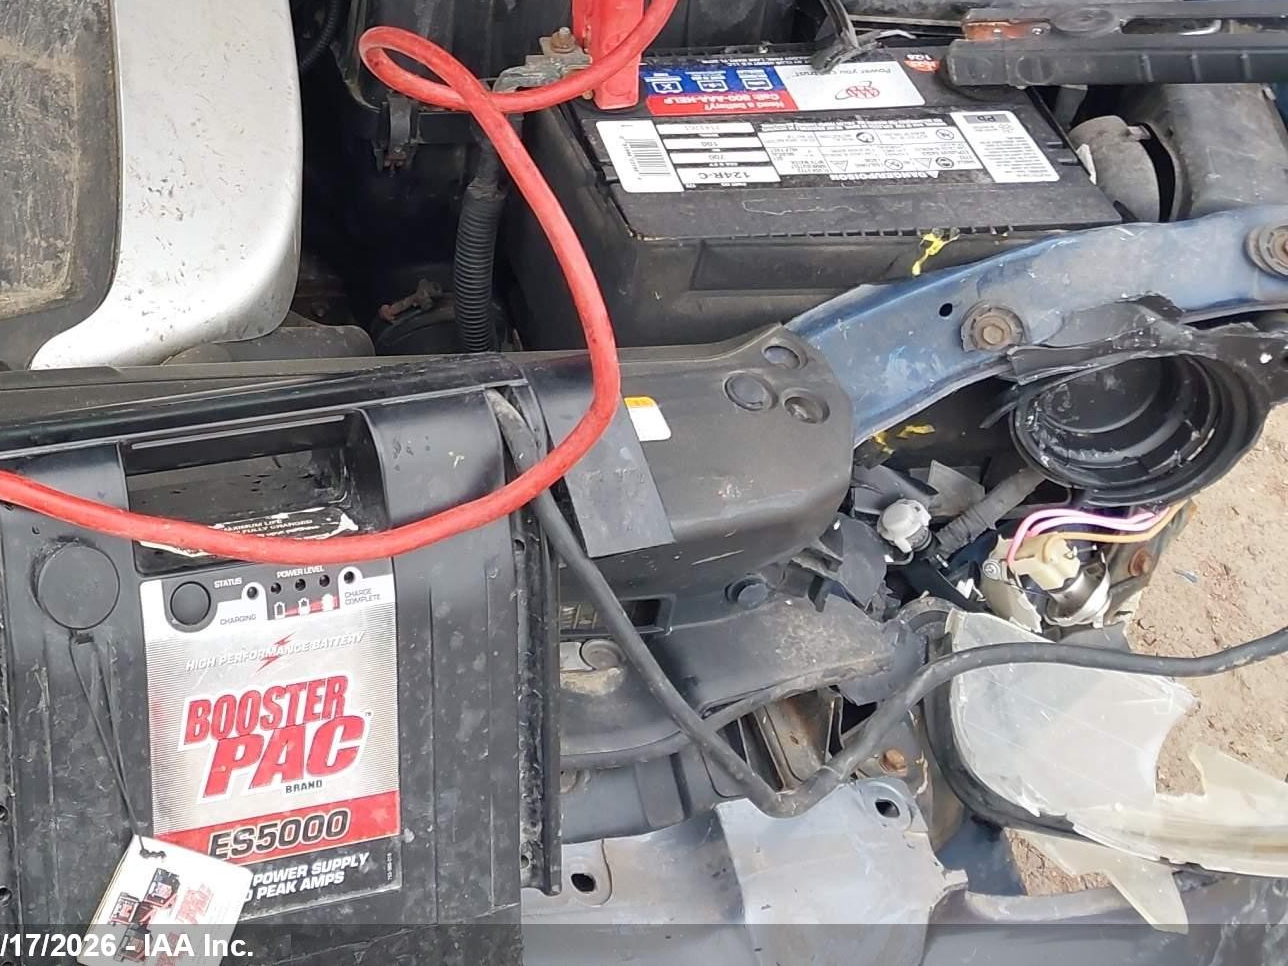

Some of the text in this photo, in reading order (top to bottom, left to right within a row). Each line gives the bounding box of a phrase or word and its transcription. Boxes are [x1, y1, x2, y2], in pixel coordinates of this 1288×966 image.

[839, 68, 858, 77] you
[860, 67, 892, 76] Power
[703, 101, 746, 112] battery?
[756, 100, 785, 110] Need
[976, 114, 997, 123] Pb
[696, 171, 752, 180] 124R-C
[275, 564, 325, 579] POWER LEVEL
[213, 577, 243, 589] STATUS
[343, 586, 373, 599] CHARGE
[344, 592, 382, 606] COMPLETE
[219, 613, 258, 626] CHARGING
[185, 631, 366, 672] HIGH PERFORMANCE BATTERY
[183, 674, 350, 746] BOOSTER
[201, 713, 368, 800] PAC
[284, 778, 324, 795] BRAND
[208, 808, 351, 860] ES5000
[253, 865, 310, 887] POWER
[310, 852, 371, 876] SUPPLY
[254, 880, 298, 902] PEAK
[298, 870, 347, 893] AMPS
